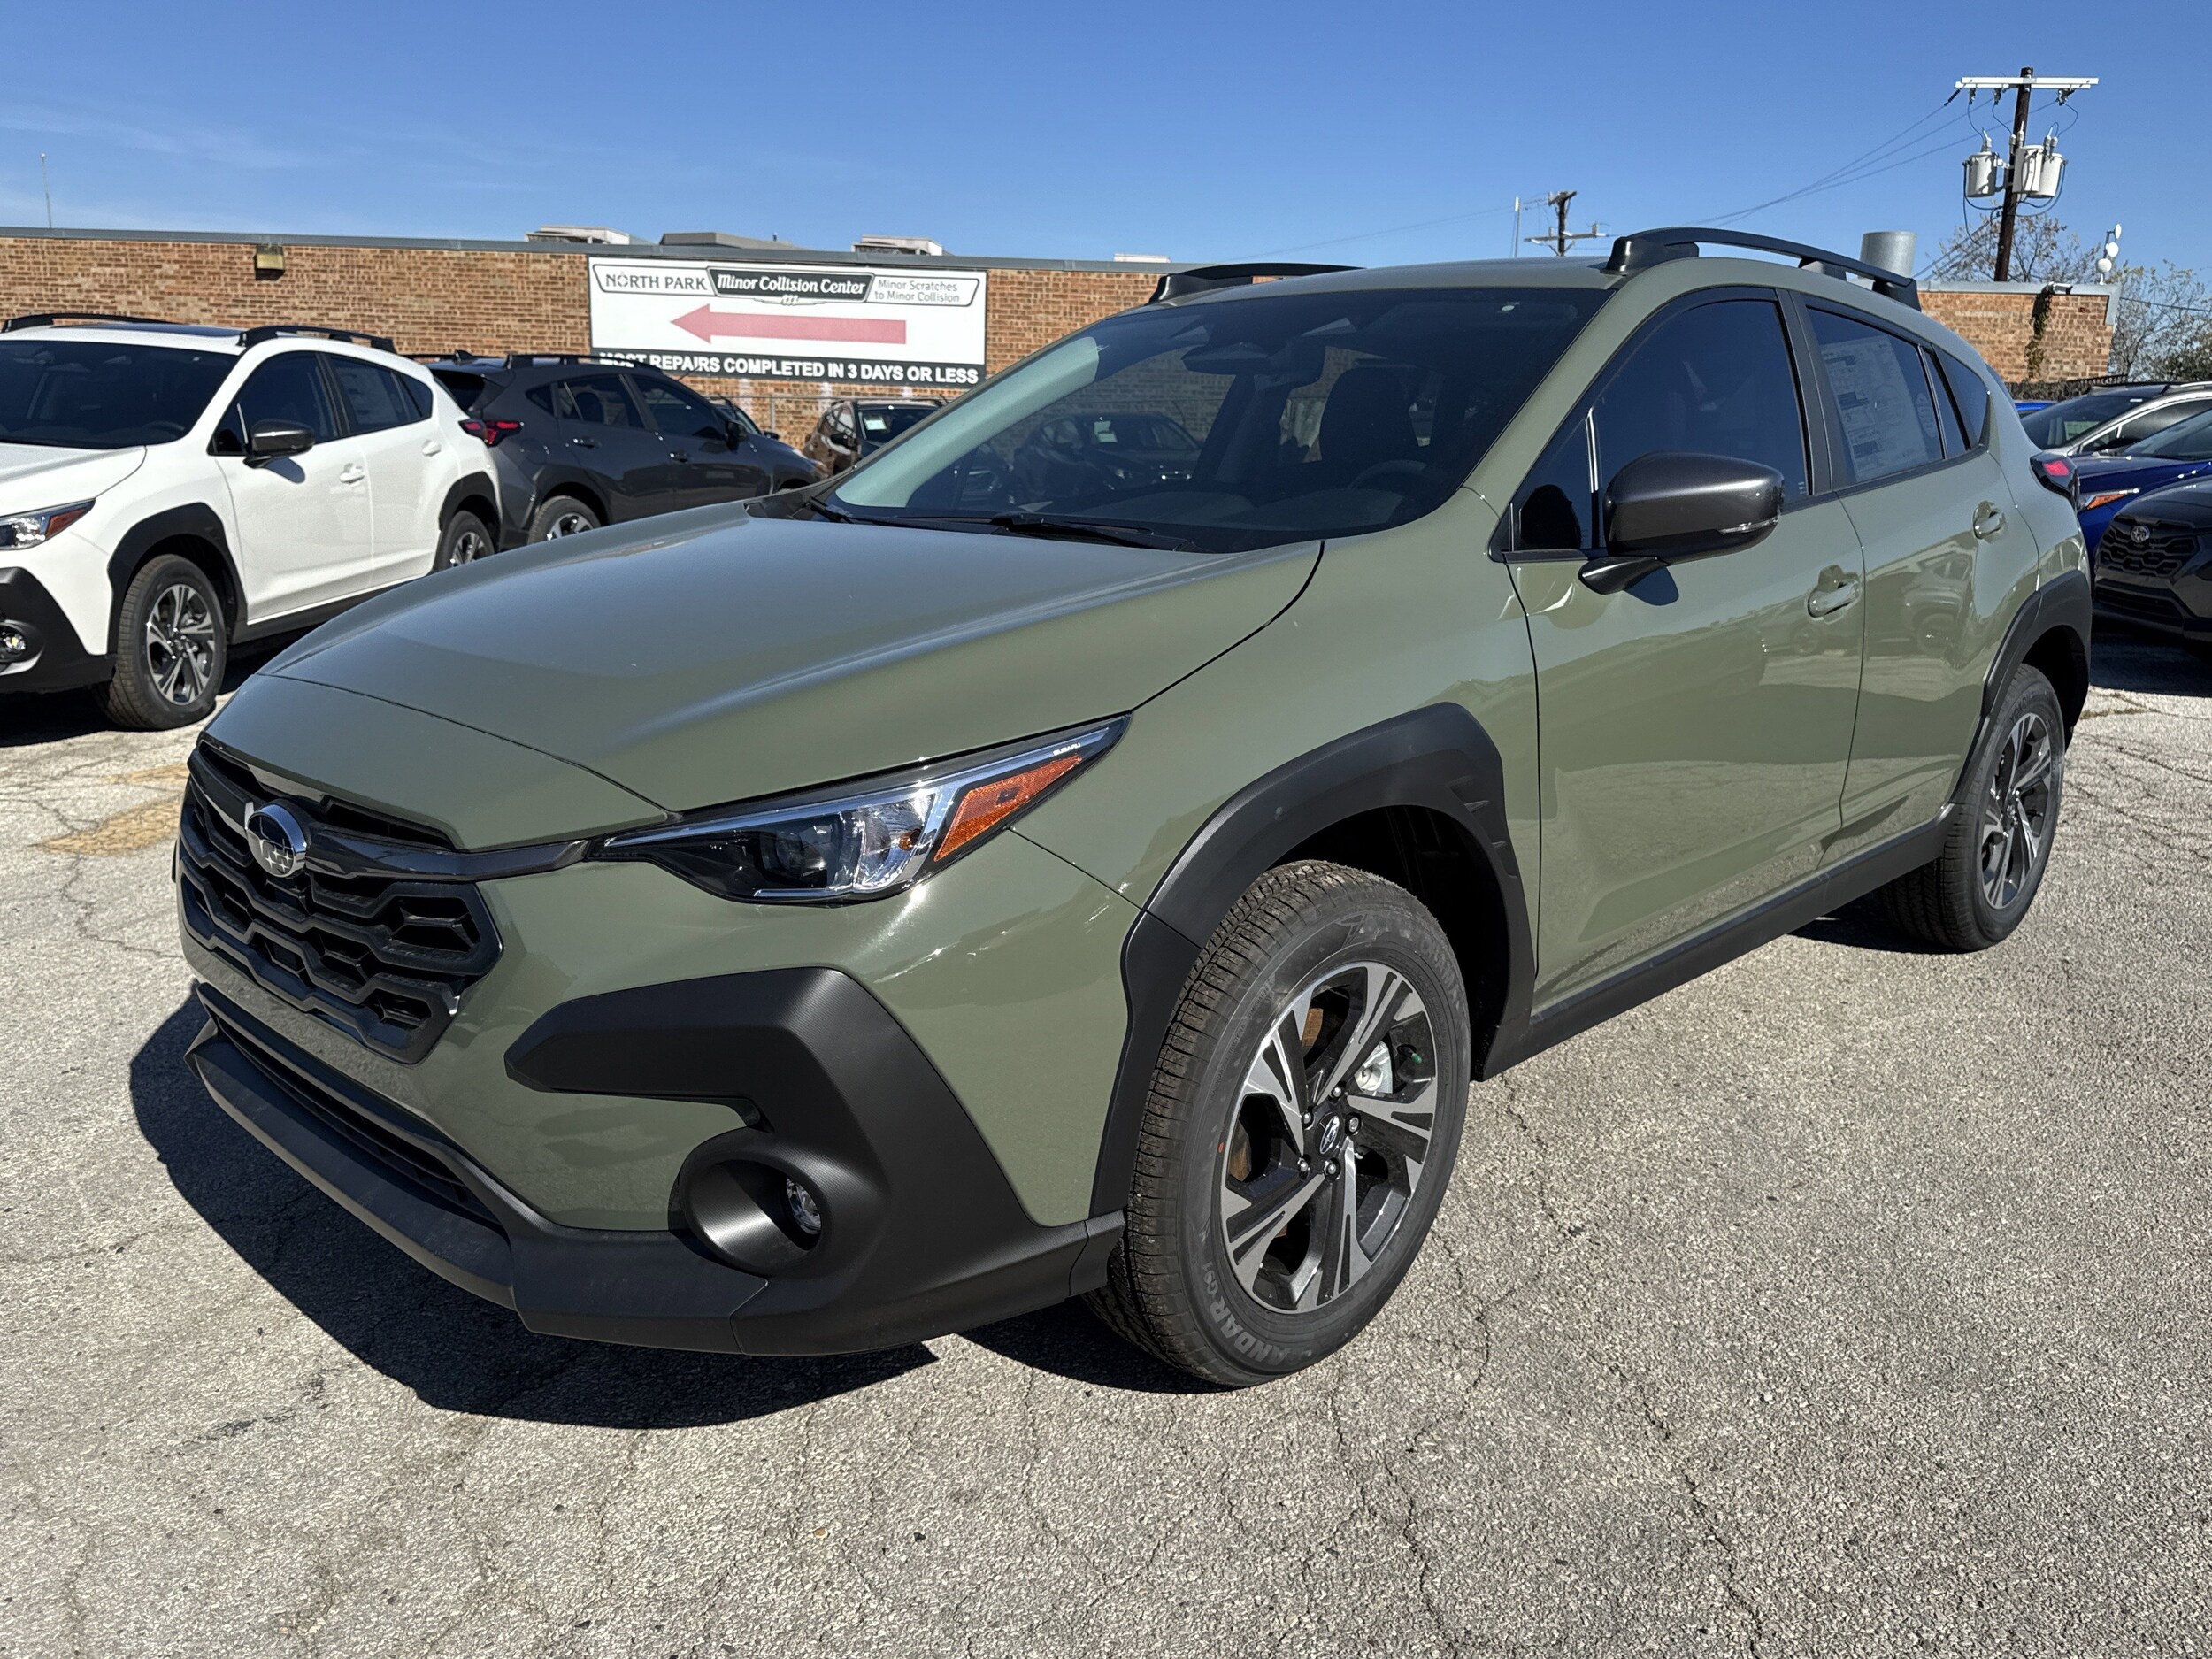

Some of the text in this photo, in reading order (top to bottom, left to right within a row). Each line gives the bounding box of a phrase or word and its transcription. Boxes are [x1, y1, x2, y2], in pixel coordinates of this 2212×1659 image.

[605, 272, 708, 291] NORTH PARK
[717, 273, 866, 295] Minor Collision Center
[878, 279, 958, 292] Minor Scratches
[875, 290, 960, 303] to Minor Collision
[649, 354, 721, 373] REPAIRS
[723, 357, 825, 377] COMPLETED
[827, 362, 844, 379] IN
[847, 363, 858, 380] 3
[861, 364, 904, 381] DAYS
[907, 366, 933, 382] OR
[935, 367, 979, 385] LESS
